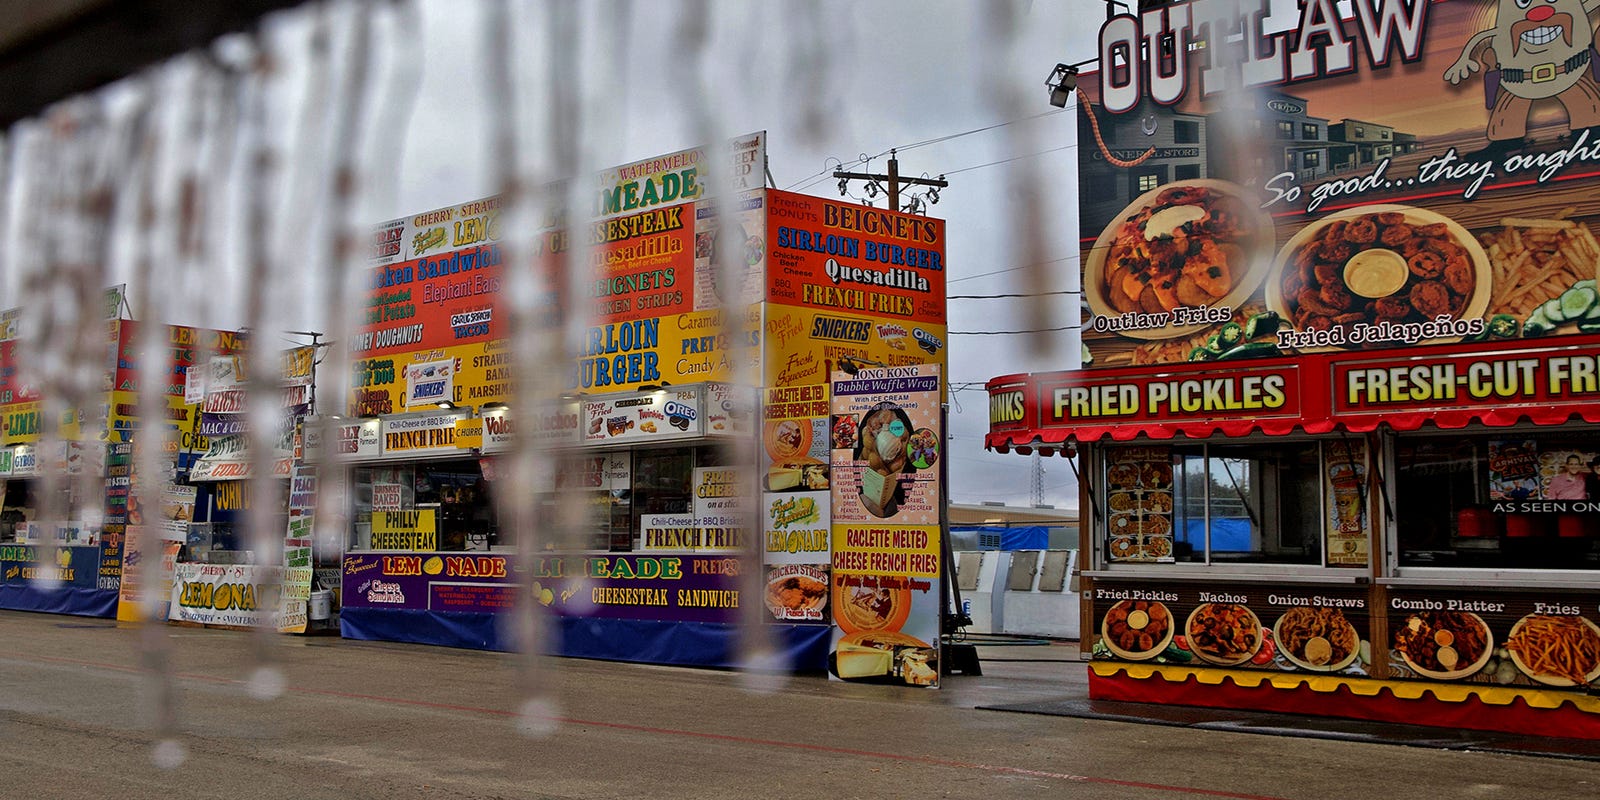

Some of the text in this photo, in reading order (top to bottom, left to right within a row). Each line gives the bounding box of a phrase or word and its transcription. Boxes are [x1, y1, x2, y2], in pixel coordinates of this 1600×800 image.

[1099, 0, 1429, 114] OUTLAW
[1162, 147, 1200, 158] STORE
[592, 168, 698, 217] IMEADE
[774, 196, 811, 211] French
[414, 208, 452, 228] CHERRY
[770, 207, 818, 223] DONUTS
[824, 203, 938, 245] BEIGNETS
[595, 237, 684, 266] uesadilla
[773, 251, 805, 262] Chicken
[778, 227, 944, 271] SIRLOIN BURGER
[417, 245, 503, 282] Sandwich
[780, 260, 798, 268] Beef
[784, 267, 814, 278] Cheese
[825, 258, 930, 291] Quesadilla
[423, 274, 502, 307] Elephant Ears
[771, 287, 797, 299] Brisket
[775, 280, 791, 289] BBQ
[637, 290, 683, 310] STRIPS
[802, 284, 914, 317] FRENCH FRIES
[384, 303, 416, 321] Potato
[1094, 305, 1233, 333] Outlaw Fries
[454, 323, 490, 339] TACOS
[677, 313, 722, 331] Caramel
[767, 314, 792, 335] Deep
[812, 317, 871, 342] SNICKERS
[376, 324, 424, 349] DOUGHNUTS
[578, 317, 660, 358] IRLOIN
[778, 319, 804, 349] Fried
[877, 324, 909, 339] Twinkies
[912, 328, 943, 348] OREO
[1276, 315, 1485, 350] Fried Jalapeños
[567, 352, 661, 389] BURGER
[676, 357, 714, 377] Candy
[788, 351, 814, 373] Fresh
[374, 369, 395, 384] DOG
[887, 367, 919, 378] KONG
[1348, 355, 1600, 405] FRESH-CUT FR
[354, 388, 389, 402] Volcano
[413, 381, 446, 399] SNICKERS
[769, 384, 824, 403] RACLETTE MELTED
[836, 378, 937, 394] Bubble Waffle Wrap
[1053, 375, 1286, 419] FRIED PICKLES
[585, 402, 605, 412] Deep
[591, 406, 613, 420] Fried
[638, 408, 664, 420] Twinkies
[665, 403, 697, 419] OREO
[765, 400, 829, 420] CHEESE FRENCH FRIES
[849, 403, 872, 412] (Vanilla
[991, 391, 1025, 425] RINKS
[201, 422, 222, 435] MAC
[390, 418, 438, 430] Chili-Cheese or BBQ
[386, 427, 457, 450] FRENCH FRIE
[14, 455, 35, 469] GYROS
[216, 482, 242, 511] CORN
[374, 484, 401, 494] BRISKET
[373, 493, 400, 506] BAKED
[707, 501, 716, 509] on
[1493, 502, 1600, 513] AS SEEN ON
[386, 511, 421, 529] PHILLY
[651, 516, 719, 527] Chili-Cheese or BBQ
[371, 532, 435, 551] CHEESESTEAK
[645, 527, 701, 549] FRENCH
[766, 530, 829, 554] LEMONADE
[847, 528, 928, 550] RACLETTE MELTED
[104, 548, 119, 557] BEEF
[102, 559, 120, 567] LAMB
[533, 556, 683, 580] LIEADE
[833, 551, 937, 574] CHEESE FRENCH FRIES
[99, 568, 122, 576] CHICKEN
[768, 565, 799, 582] CHICKEN
[800, 564, 827, 582] STRIPS
[99, 576, 120, 590] GYROS
[371, 579, 402, 593] Cheese
[367, 590, 405, 605] Sandwich
[438, 592, 476, 600] WATERMELON
[592, 588, 740, 608] CHEESESTEAK SANDWICH
[1096, 588, 1178, 602] Fried Pickles
[1199, 592, 1248, 604] Nachos
[1268, 594, 1365, 609] Onion Straws
[1391, 598, 1506, 612] Combo Platter
[1534, 602, 1581, 616] Fries
